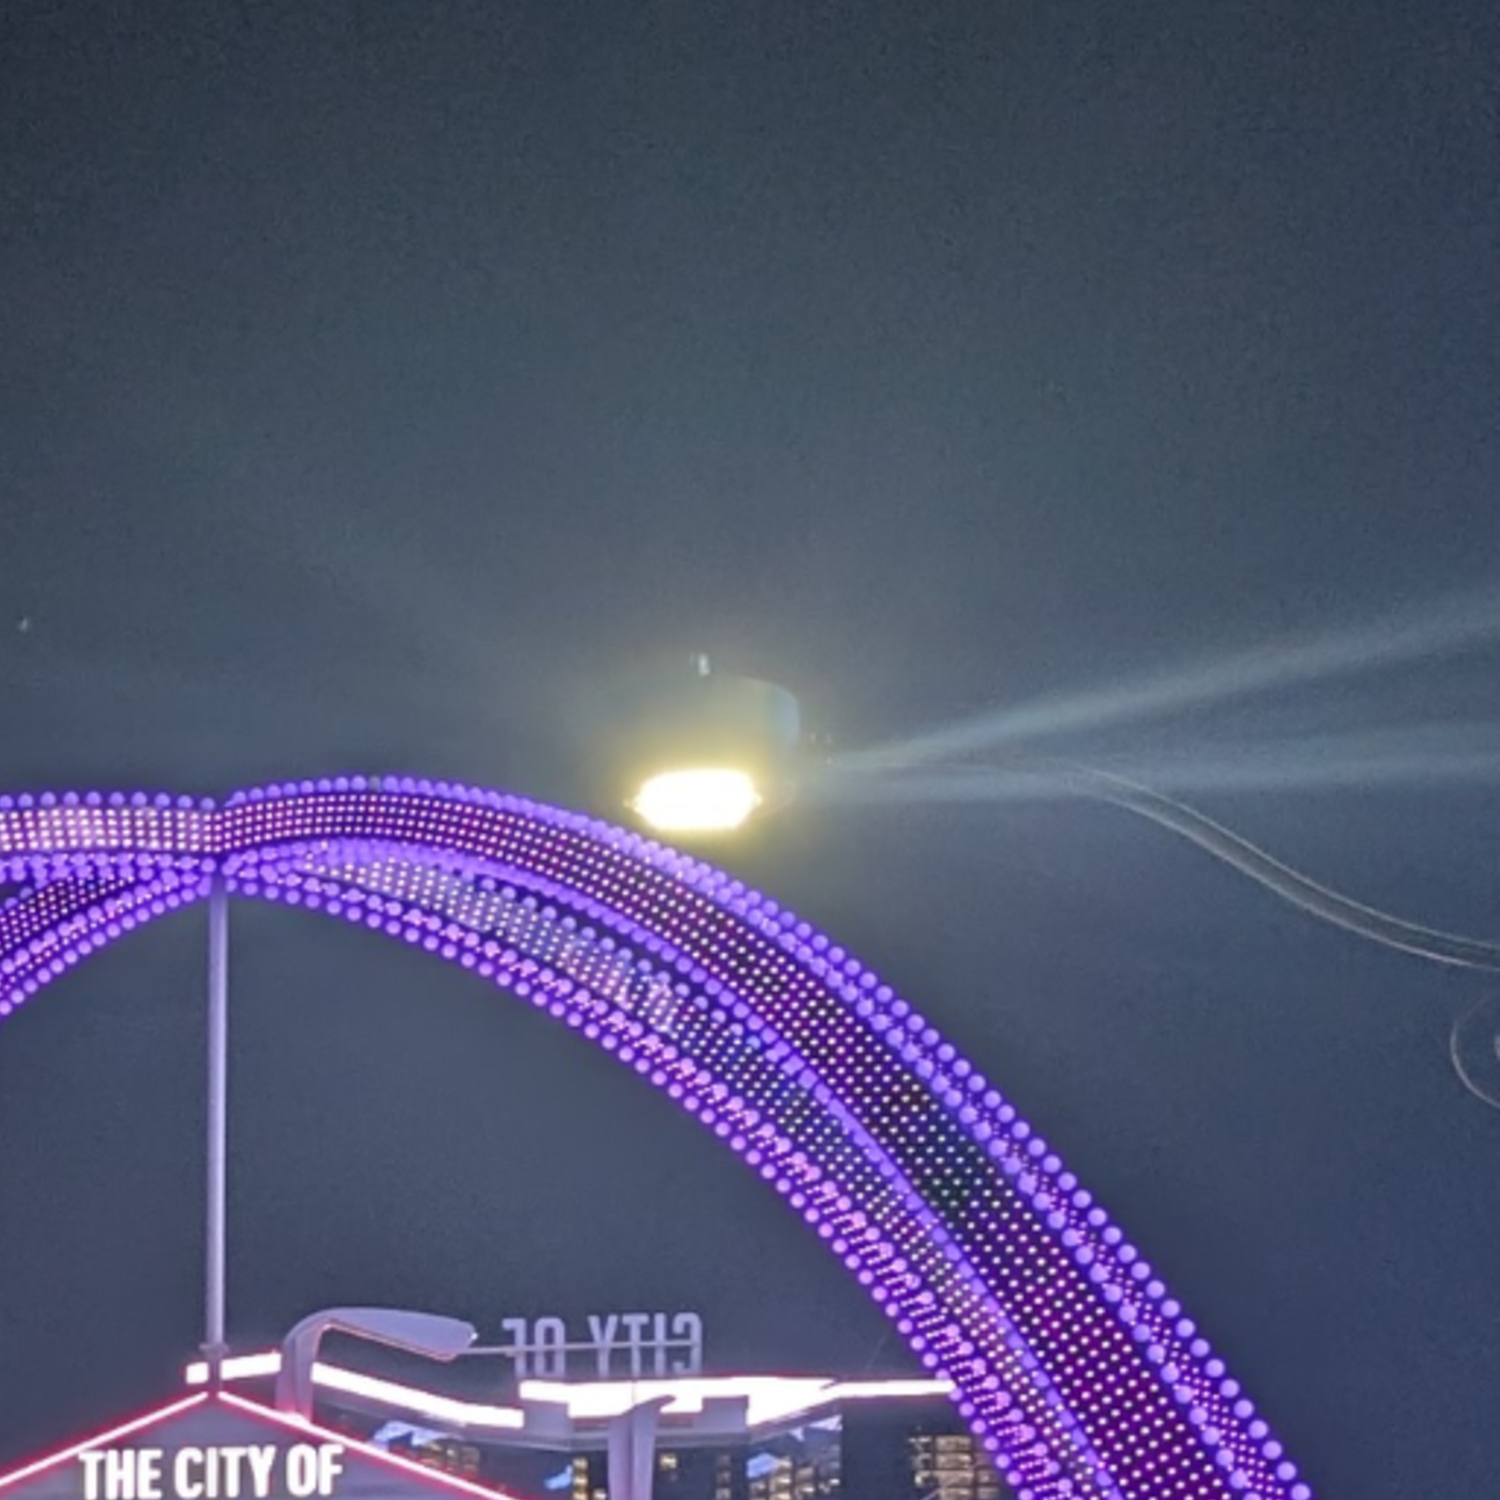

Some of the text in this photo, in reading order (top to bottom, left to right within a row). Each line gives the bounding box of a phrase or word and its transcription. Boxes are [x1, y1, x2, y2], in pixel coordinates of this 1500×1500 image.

[78, 1444, 344, 1500] THE CITY OF
